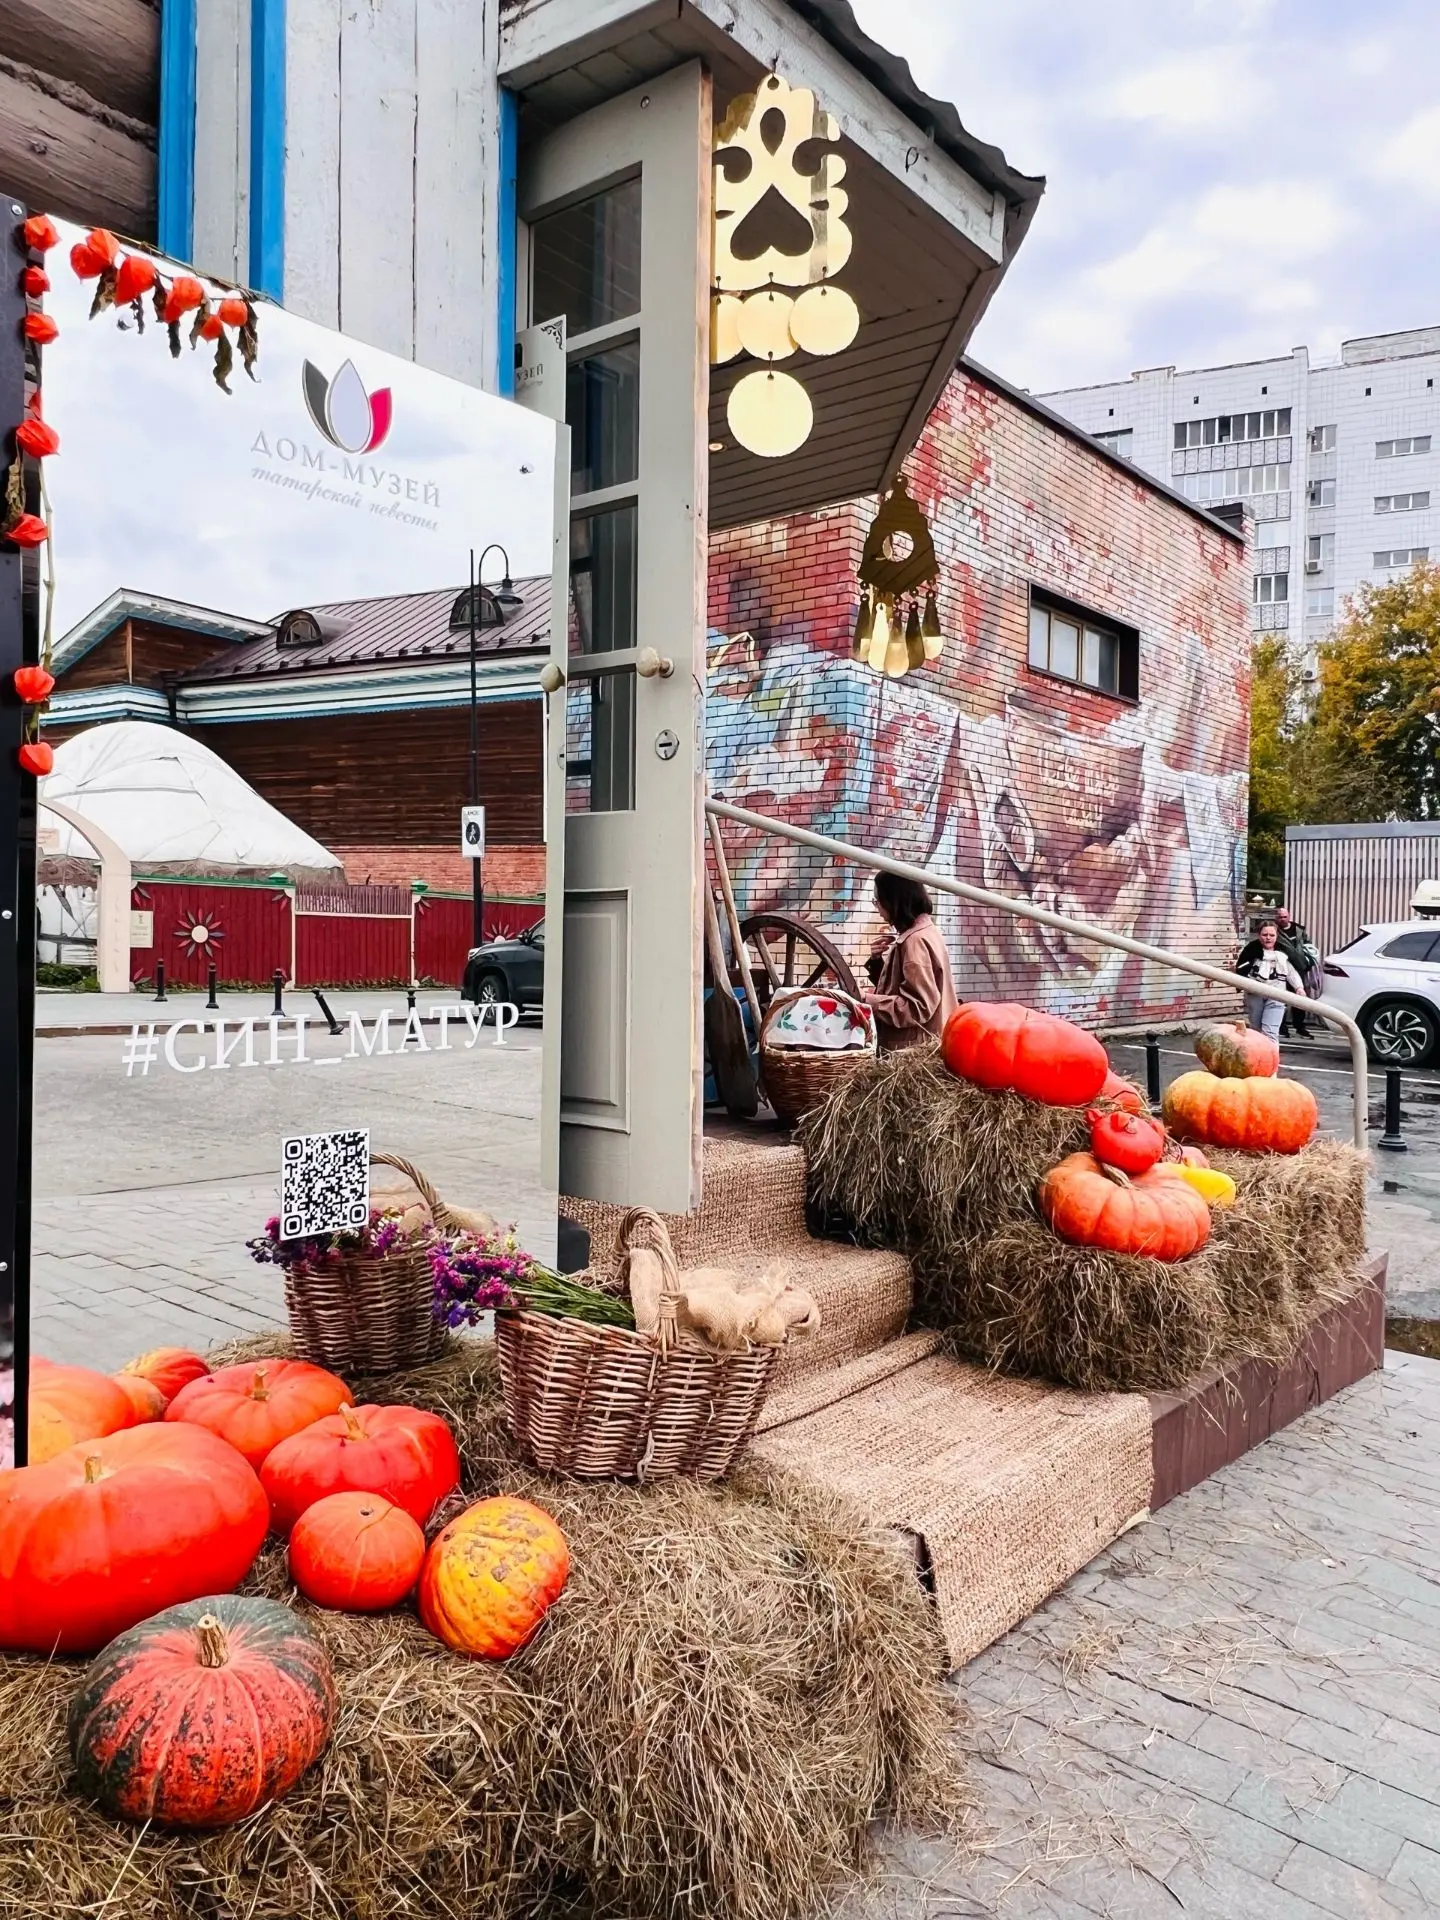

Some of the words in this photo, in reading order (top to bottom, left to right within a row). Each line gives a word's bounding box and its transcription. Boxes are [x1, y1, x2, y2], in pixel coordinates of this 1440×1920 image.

[250, 430, 441, 508] ДОМ-МУЗЕЙ
[251, 466, 363, 509] татарской
[369, 502, 440, 532] невесты
[121, 1000, 520, 1077] #СИН_МАТУР
